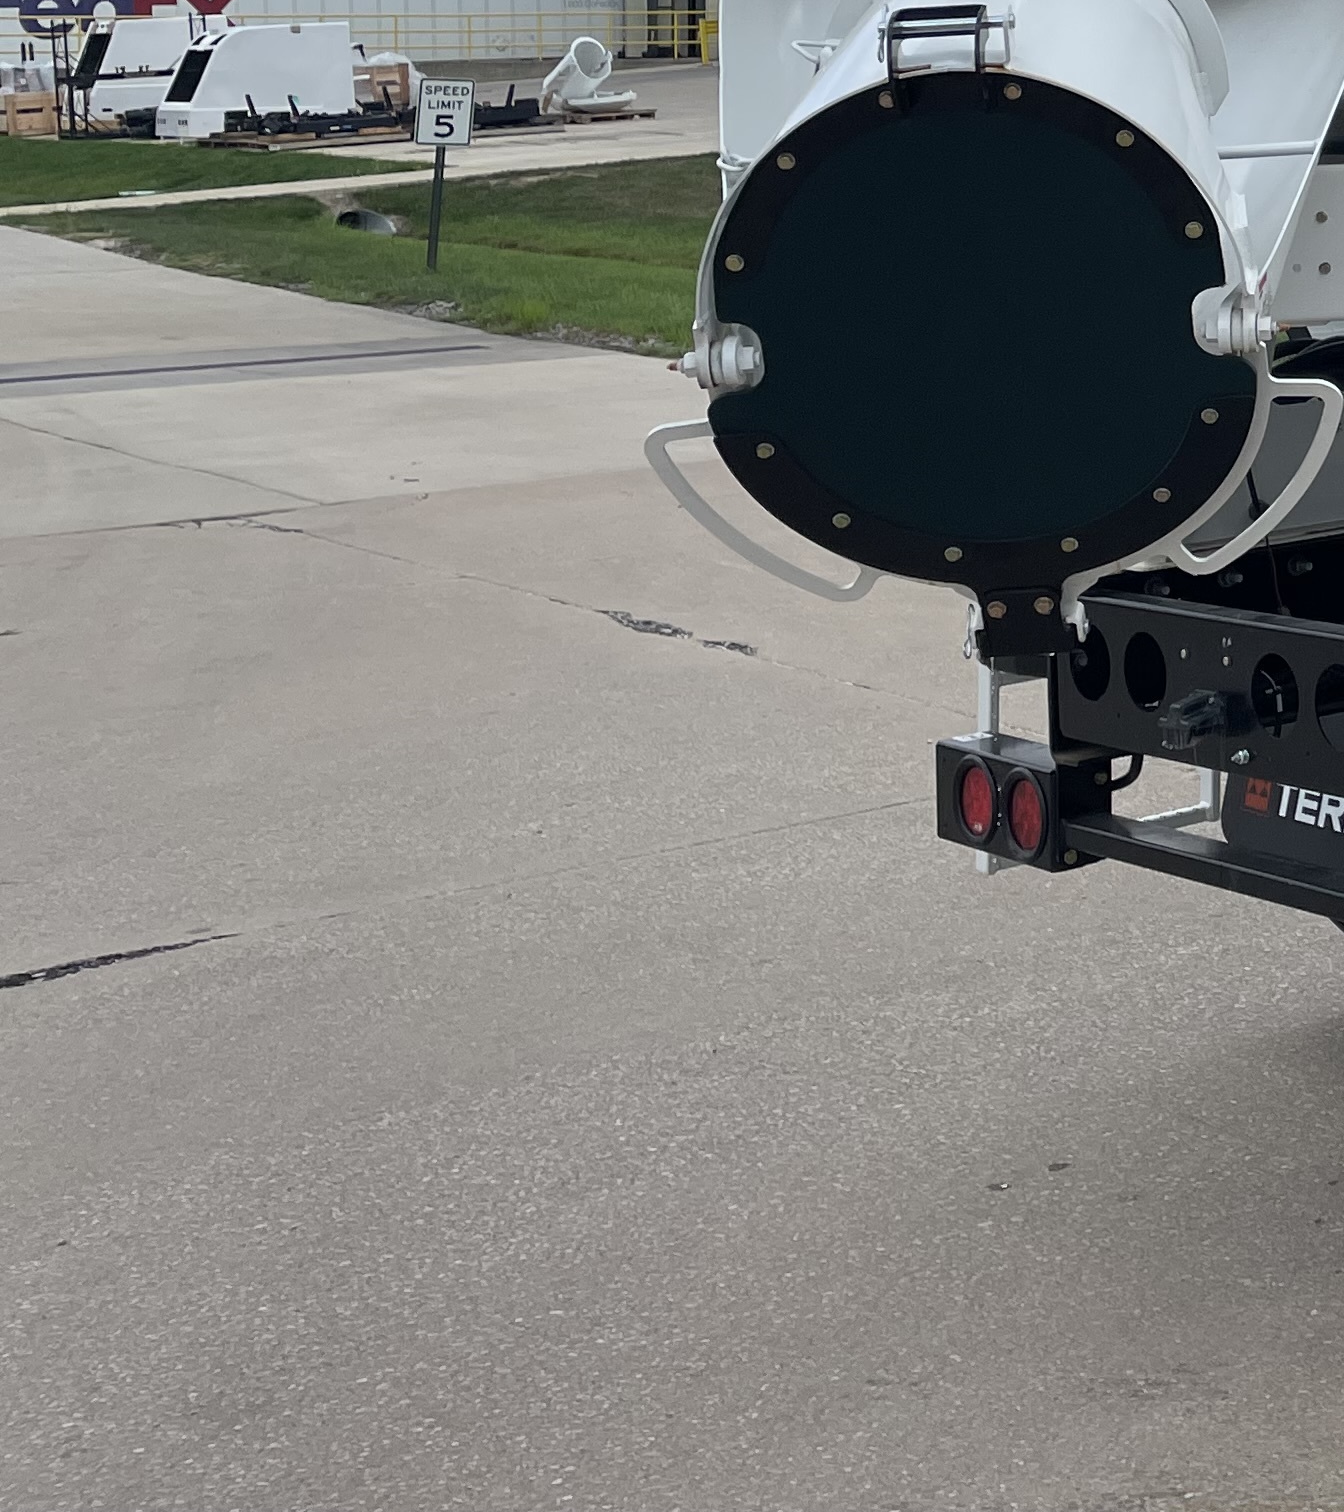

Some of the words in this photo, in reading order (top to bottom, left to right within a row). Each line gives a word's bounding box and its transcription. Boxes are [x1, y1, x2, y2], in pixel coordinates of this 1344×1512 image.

[425, 85, 470, 96] SPEED
[428, 99, 464, 110] LIMIT
[433, 114, 454, 138] 5
